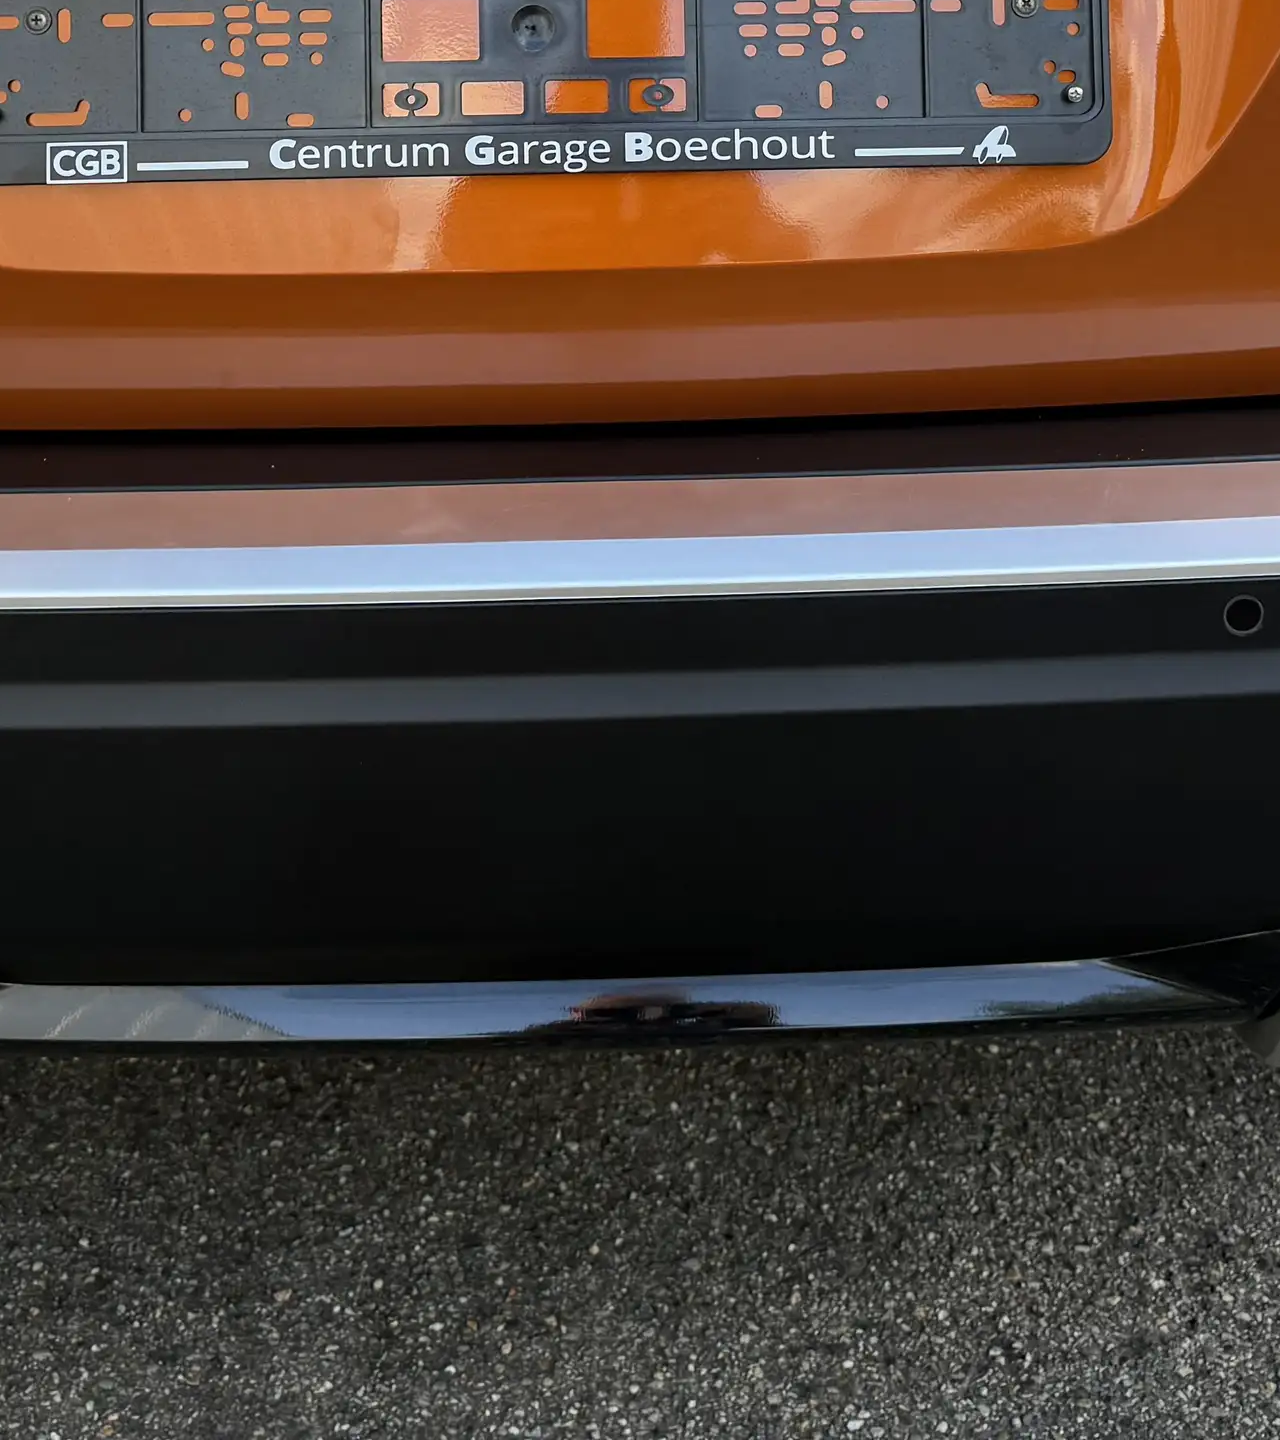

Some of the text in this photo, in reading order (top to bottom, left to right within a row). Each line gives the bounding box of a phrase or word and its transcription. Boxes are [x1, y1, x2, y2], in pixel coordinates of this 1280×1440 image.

[52, 128, 836, 178] CGB Centrum Garage Boechout
